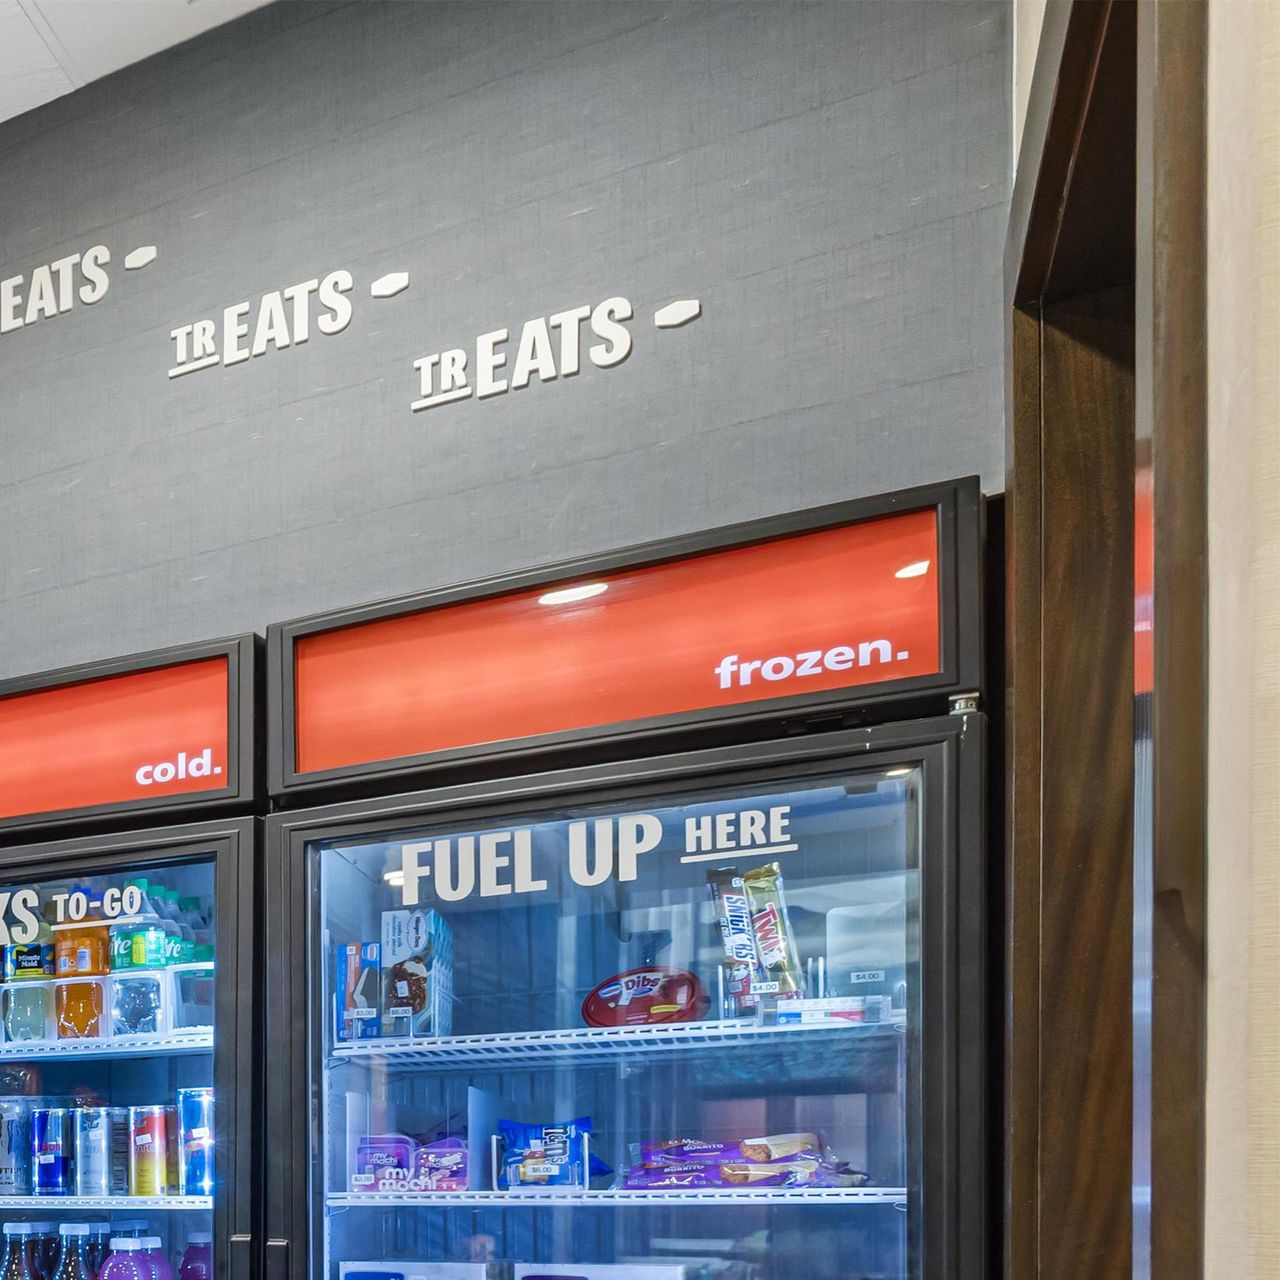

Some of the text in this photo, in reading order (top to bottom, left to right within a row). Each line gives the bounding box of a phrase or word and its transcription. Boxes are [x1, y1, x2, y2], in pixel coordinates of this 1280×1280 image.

[169, 270, 354, 372] TREATS
[411, 296, 634, 405] TREATS
[715, 636, 910, 690] frozen.
[135, 748, 223, 787] cold.
[401, 805, 792, 906] FUEL UP HERE
[52, 885, 142, 923] TO-GO
[855, 972, 880, 981] $4.00
